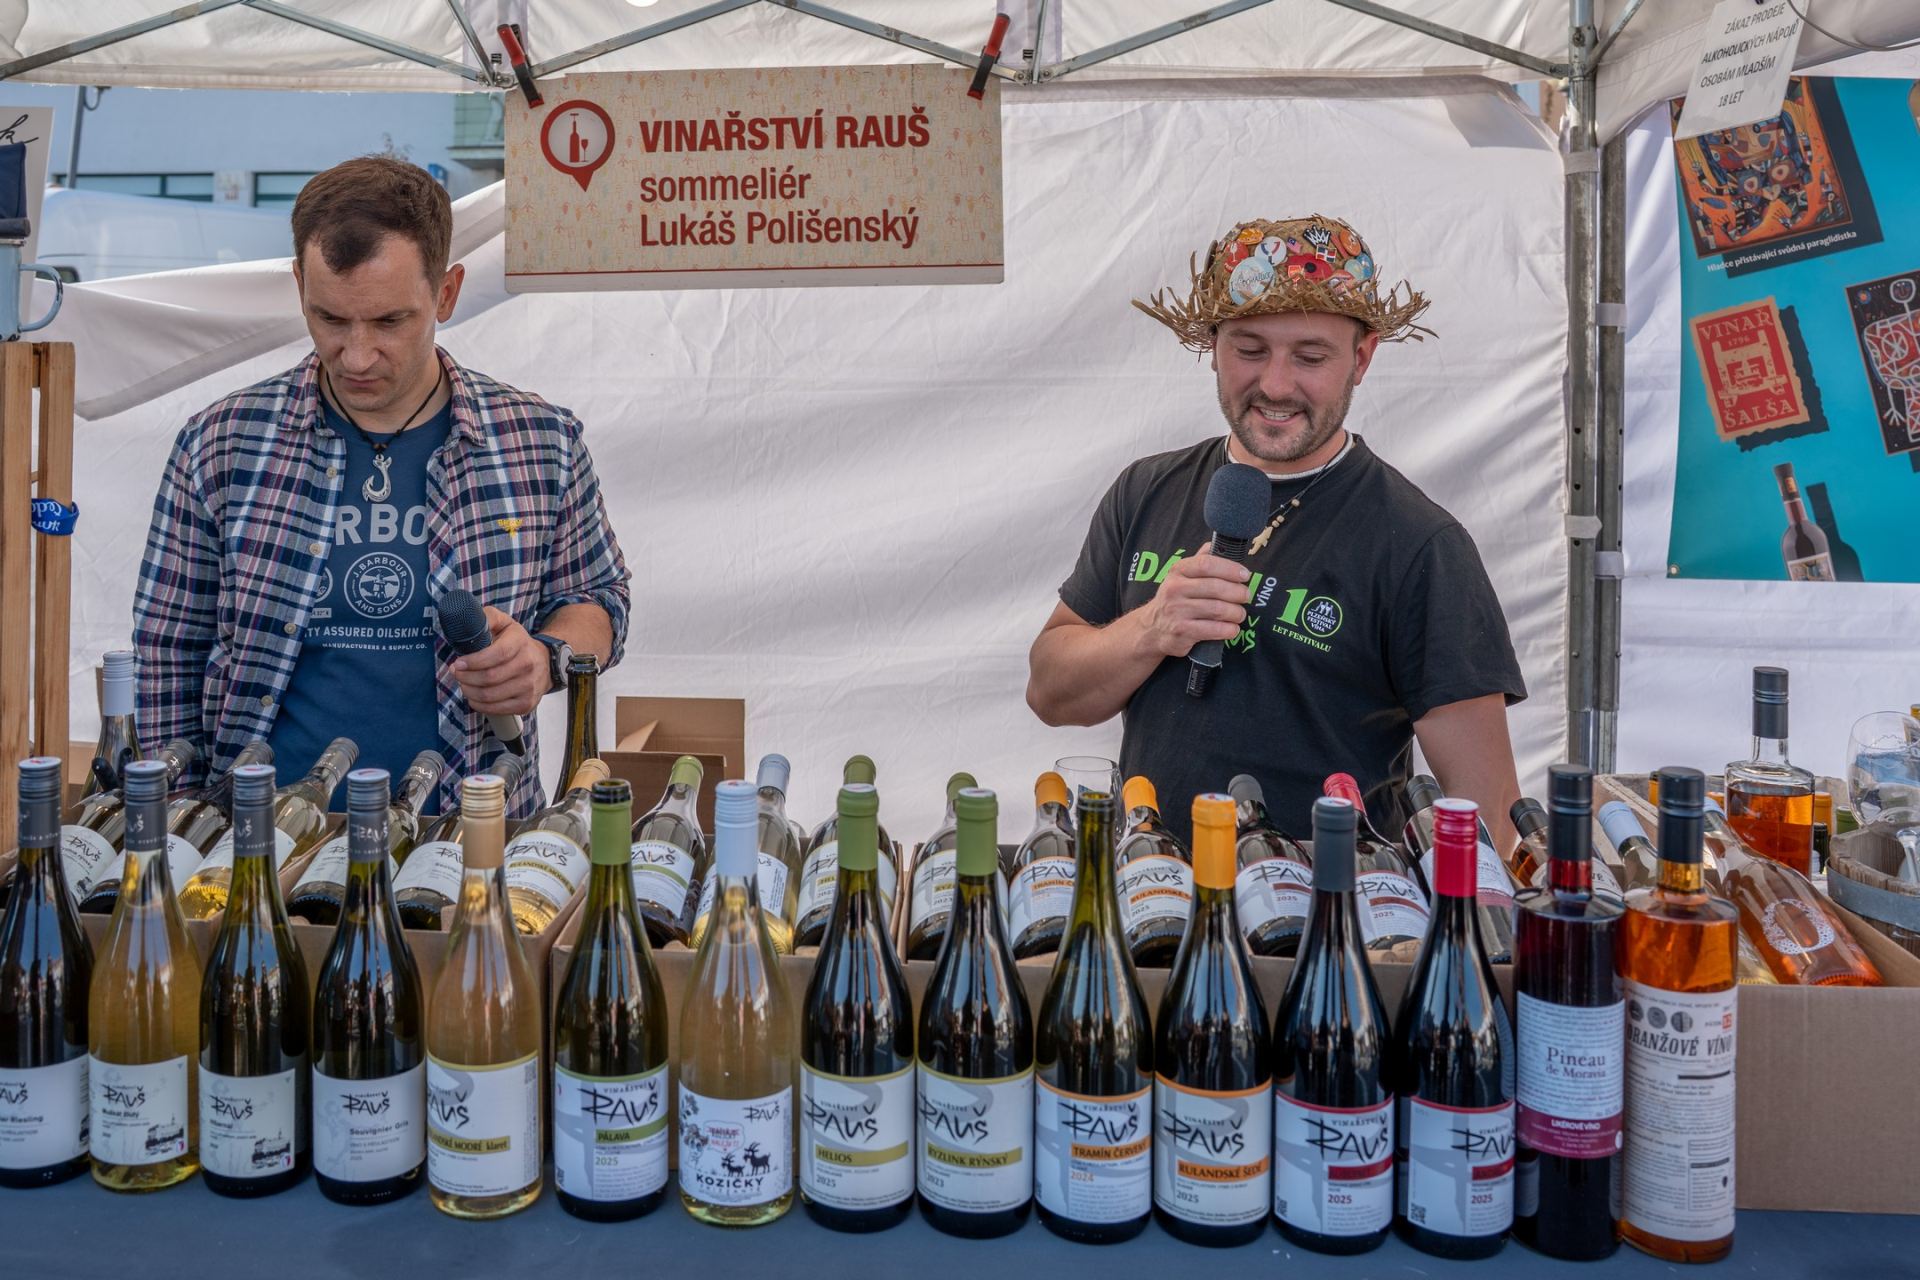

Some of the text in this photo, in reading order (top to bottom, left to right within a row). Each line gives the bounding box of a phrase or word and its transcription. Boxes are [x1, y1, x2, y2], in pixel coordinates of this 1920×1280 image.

[1725, 3, 1786, 34] ZÁKAZ PRODEJE
[1701, 33, 1766, 64] ALKOHOLICKÝCH
[1700, 55, 1776, 88] OSOBÁM MLADŠÍM
[1718, 90, 1744, 107] 18 LET
[639, 107, 930, 153] VINAŘSTVÍ RAUŠ
[640, 166, 811, 203] sommeliér
[640, 207, 920, 249] Lukáš Polišenský
[1707, 231, 1857, 272] Hladce přistávající svůdná paraglidistka
[1699, 309, 1774, 341] VINAŘ
[1725, 397, 1795, 428] ŠALŠA
[1128, 552, 1140, 582] PRO
[1255, 577, 1278, 607] VÍNO
[355, 598, 402, 615] AND SONS
[323, 626, 373, 639] ASSURED
[377, 626, 419, 639] OILSKIN
[422, 626, 434, 637] CL
[1272, 625, 1331, 653] LET FESTIVALU
[322, 643, 380, 651] MANUFACTURERS
[632, 847, 677, 865] AUŠ
[1546, 1064, 1560, 1075] de
[1547, 1047, 1606, 1067] Pineau
[100, 1083, 146, 1108] RAUŠ
[208, 1095, 254, 1120] RAUŠ
[339, 1090, 391, 1117] RAUŠ
[578, 1078, 659, 1126] RAUŠ
[350, 1125, 393, 1136] Souvignier
[804, 1094, 879, 1144] RAUŠ
[919, 1091, 990, 1145] RAUŠ
[1058, 1103, 1139, 1145] RAUŠ
[1161, 1109, 1245, 1159] RAUŠ
[1300, 1112, 1388, 1163] RAUŠ
[595, 1156, 619, 1166] 2025
[818, 1148, 853, 1163] HELIOS
[968, 1152, 1009, 1167] RÝNSKÝ
[1074, 1147, 1112, 1159] TRAMÍN
[696, 1173, 764, 1189] KOZIČKY
[1178, 1164, 1240, 1179] RULANDSKÉ
[1176, 1191, 1200, 1204] 2025
[1328, 1194, 1352, 1204] 2025
[1471, 1194, 1493, 1205] 2025
